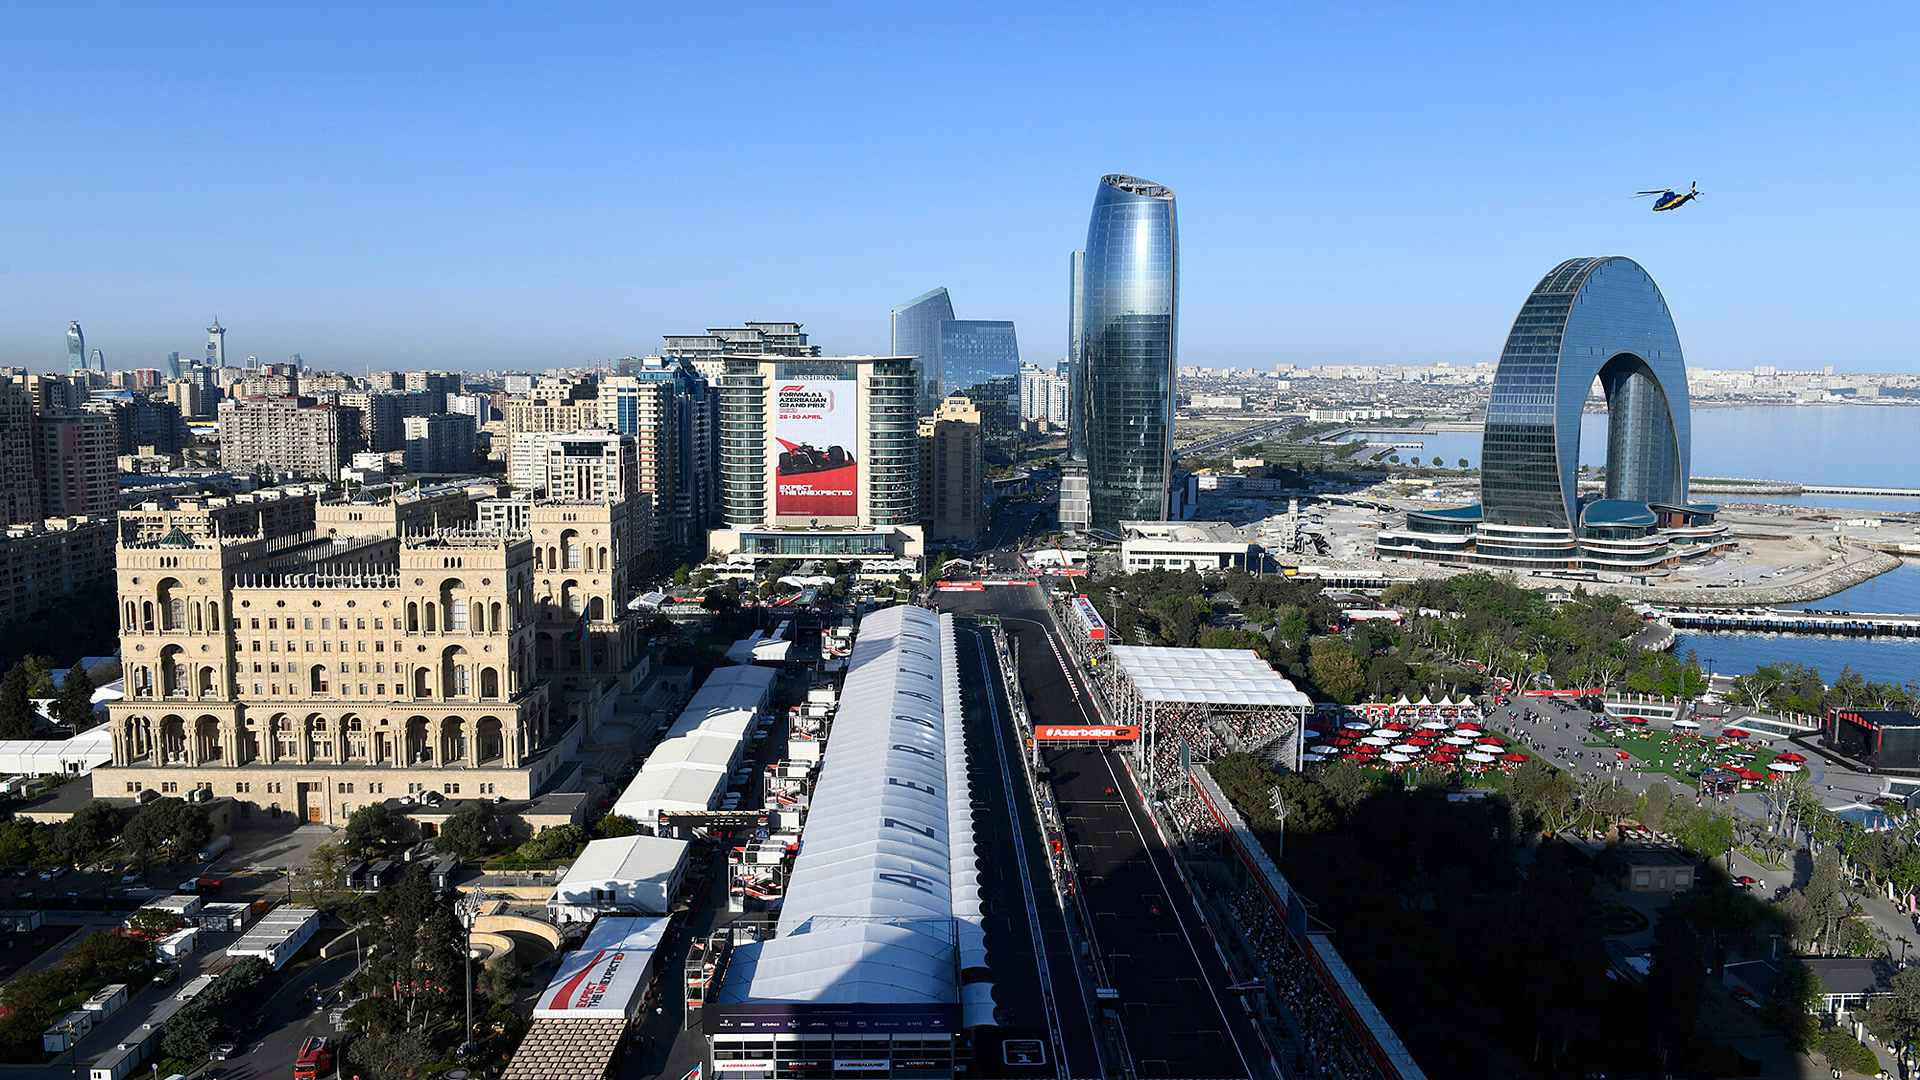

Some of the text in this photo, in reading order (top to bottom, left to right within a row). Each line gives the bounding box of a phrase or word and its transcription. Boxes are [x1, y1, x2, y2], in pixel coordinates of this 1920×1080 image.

[1046, 728, 1131, 737] #AzerbaijanGP
[587, 952, 625, 1008] THE UNEXPECTED
[575, 982, 598, 1008] EXPECT
